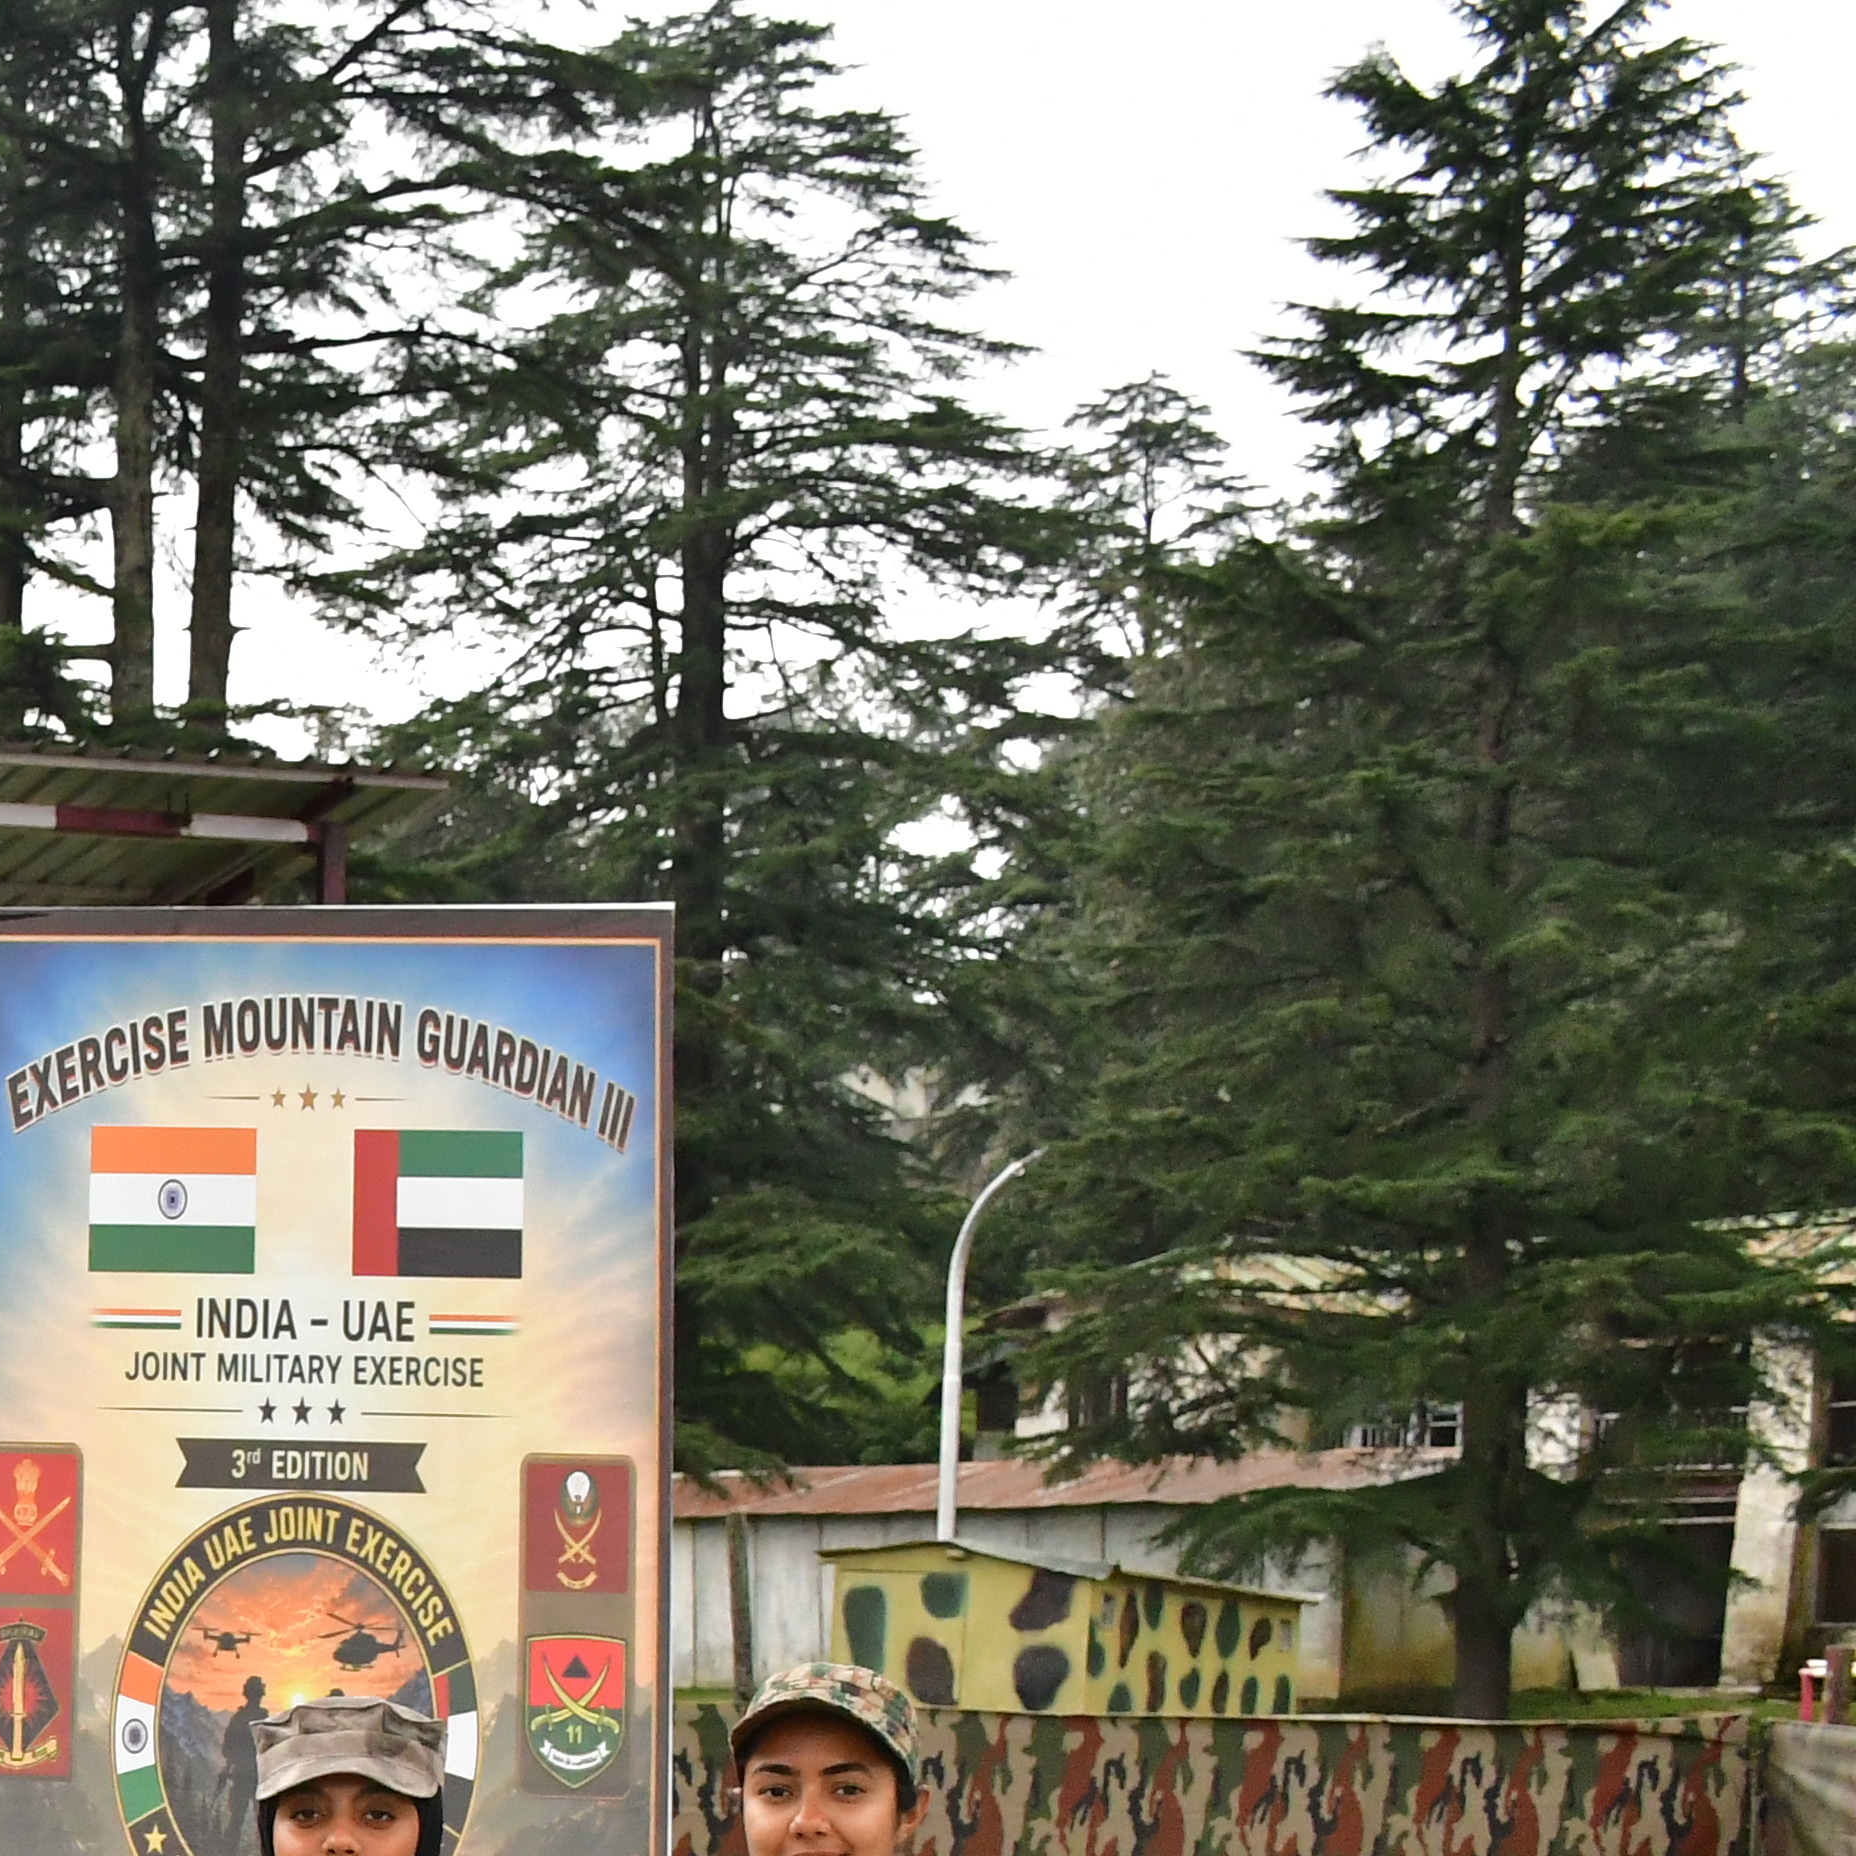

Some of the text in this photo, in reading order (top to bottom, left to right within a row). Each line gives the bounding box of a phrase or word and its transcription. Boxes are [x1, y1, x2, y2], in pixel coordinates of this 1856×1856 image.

[5, 996, 637, 1151] EXERCISE MOUNTAIN GUARDIAN III
[196, 1298, 298, 1340] INDIA
[342, 1299, 416, 1342] UAE
[125, 1351, 484, 1388] JOINT MILITARY EXERCISE
[231, 1448, 369, 1482] 3rd EDITION
[143, 1505, 455, 1647] INDIA UAE JOINT EXERCISE
[565, 1724, 584, 1744] 11
